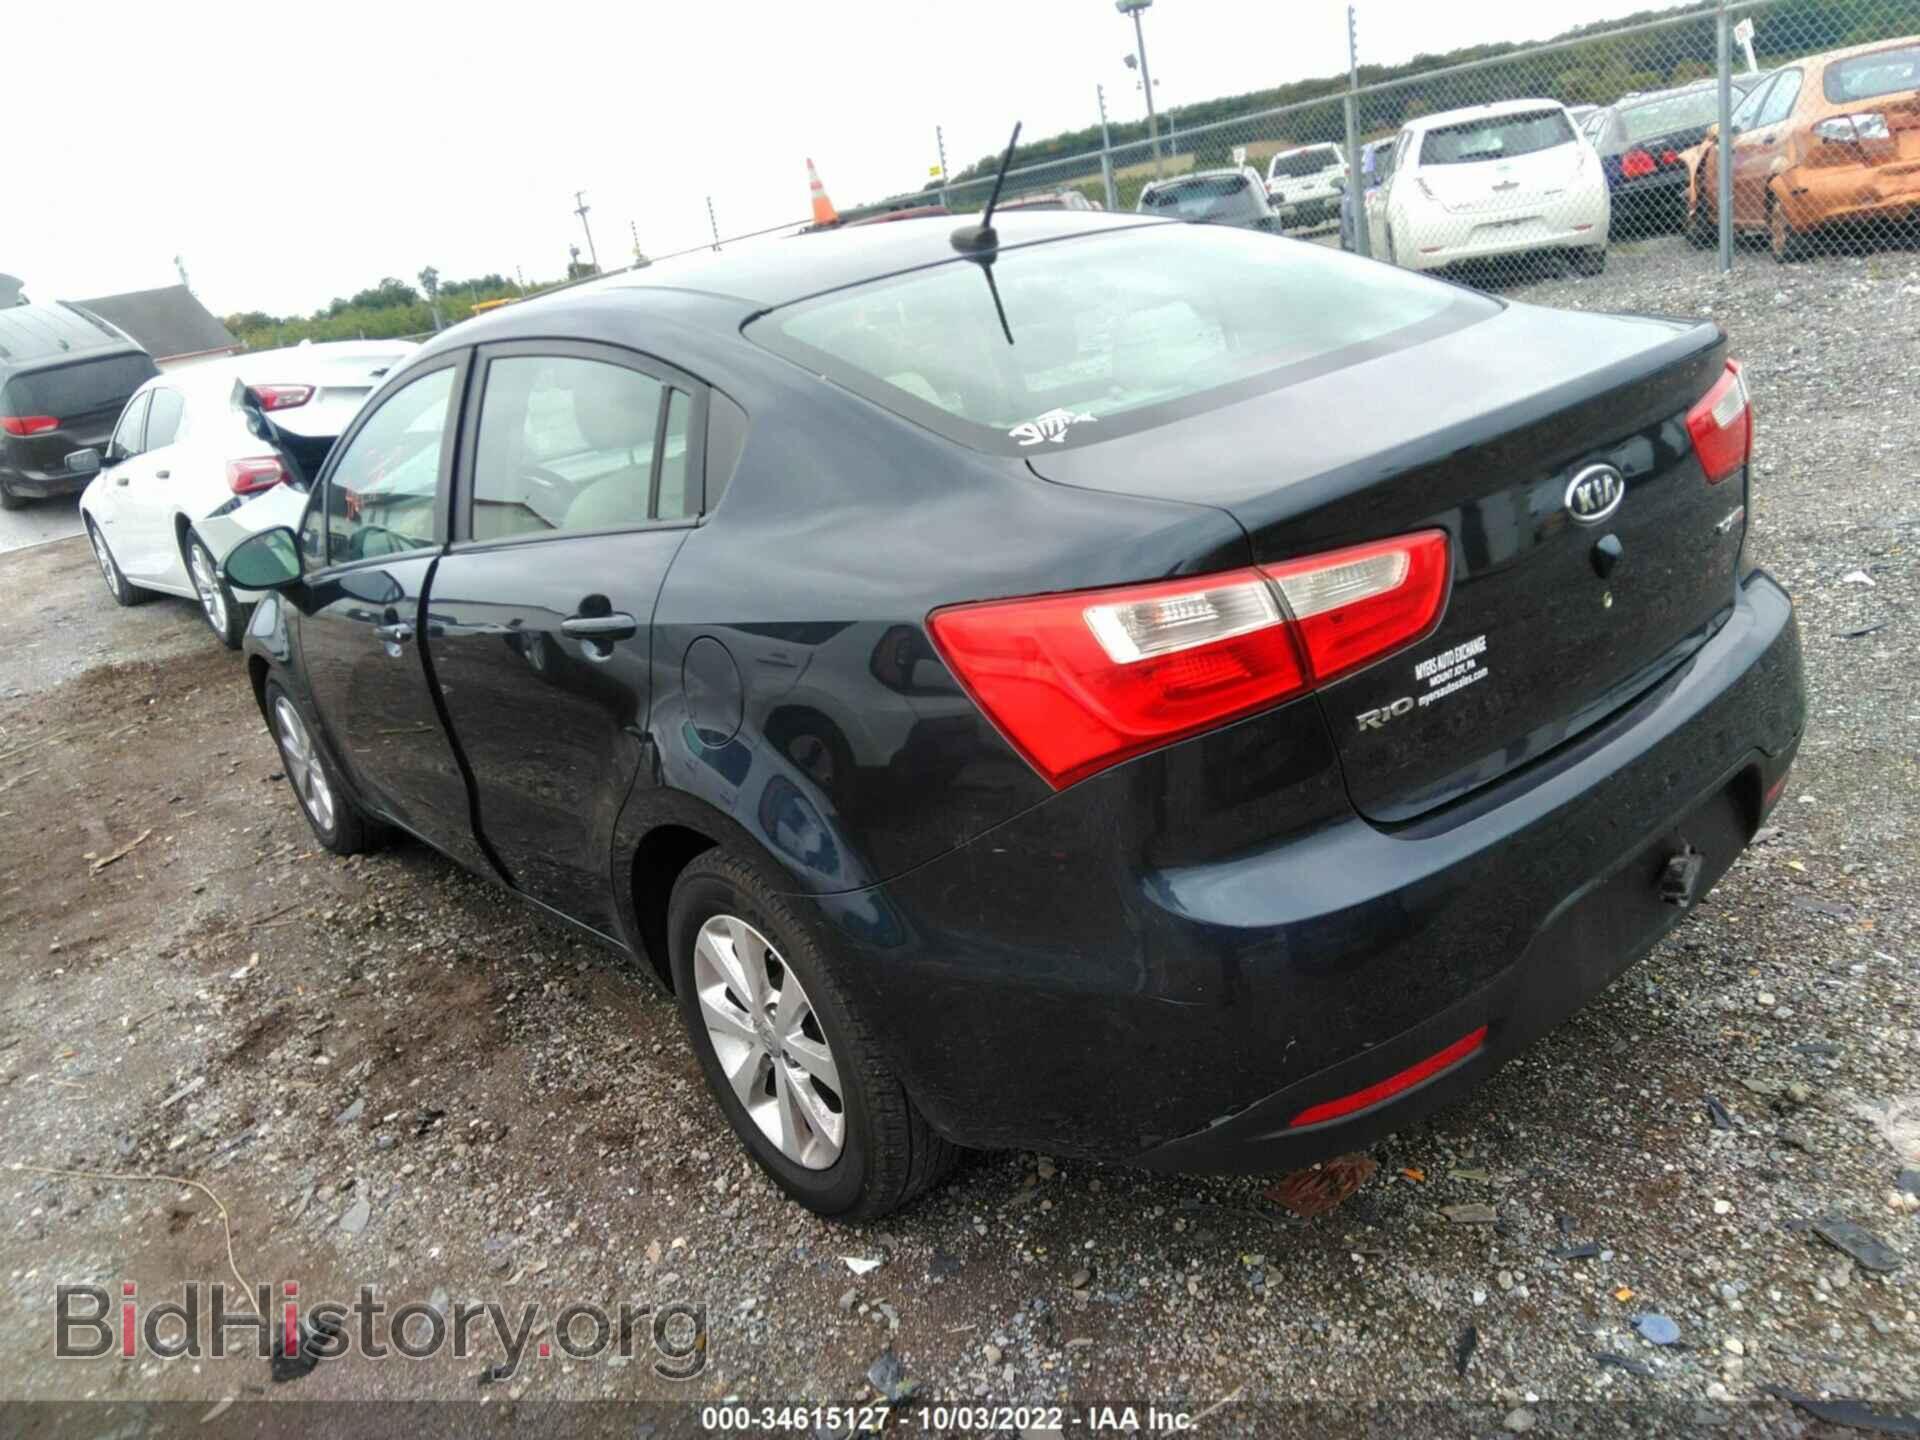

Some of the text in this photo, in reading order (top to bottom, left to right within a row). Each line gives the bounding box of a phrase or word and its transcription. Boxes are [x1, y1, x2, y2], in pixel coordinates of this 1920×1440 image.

[1576, 474, 1617, 514] KIA
[1437, 649, 1455, 671] AUTO
[1454, 634, 1488, 664] EXCHANGE
[1429, 668, 1453, 687] MOUNT
[1466, 658, 1476, 671] PA
